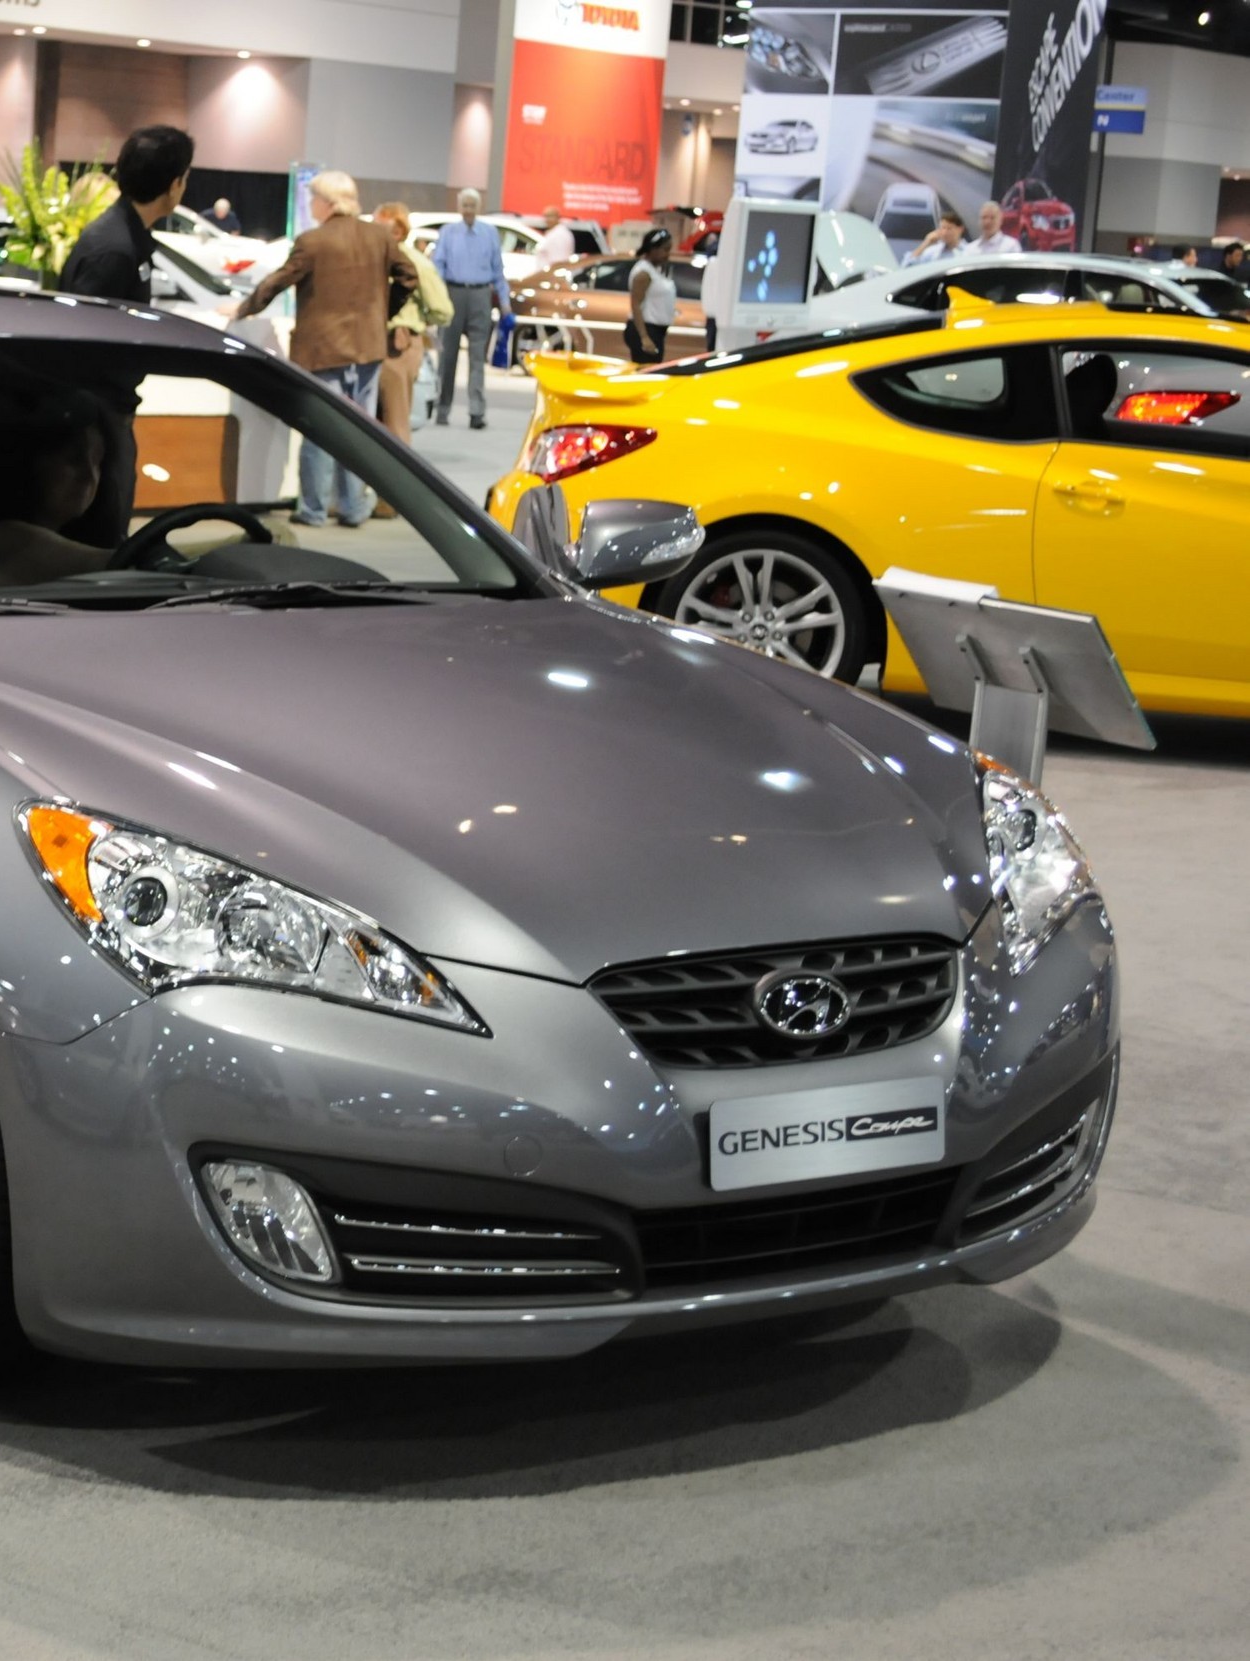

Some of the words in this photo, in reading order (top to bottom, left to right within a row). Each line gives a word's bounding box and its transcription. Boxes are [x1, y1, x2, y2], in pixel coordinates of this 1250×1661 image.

[581, 2, 640, 31] TOYOTA
[519, 133, 647, 181] STANDARD
[718, 1118, 844, 1156] GENESIS
[850, 1115, 934, 1136] Coupe
